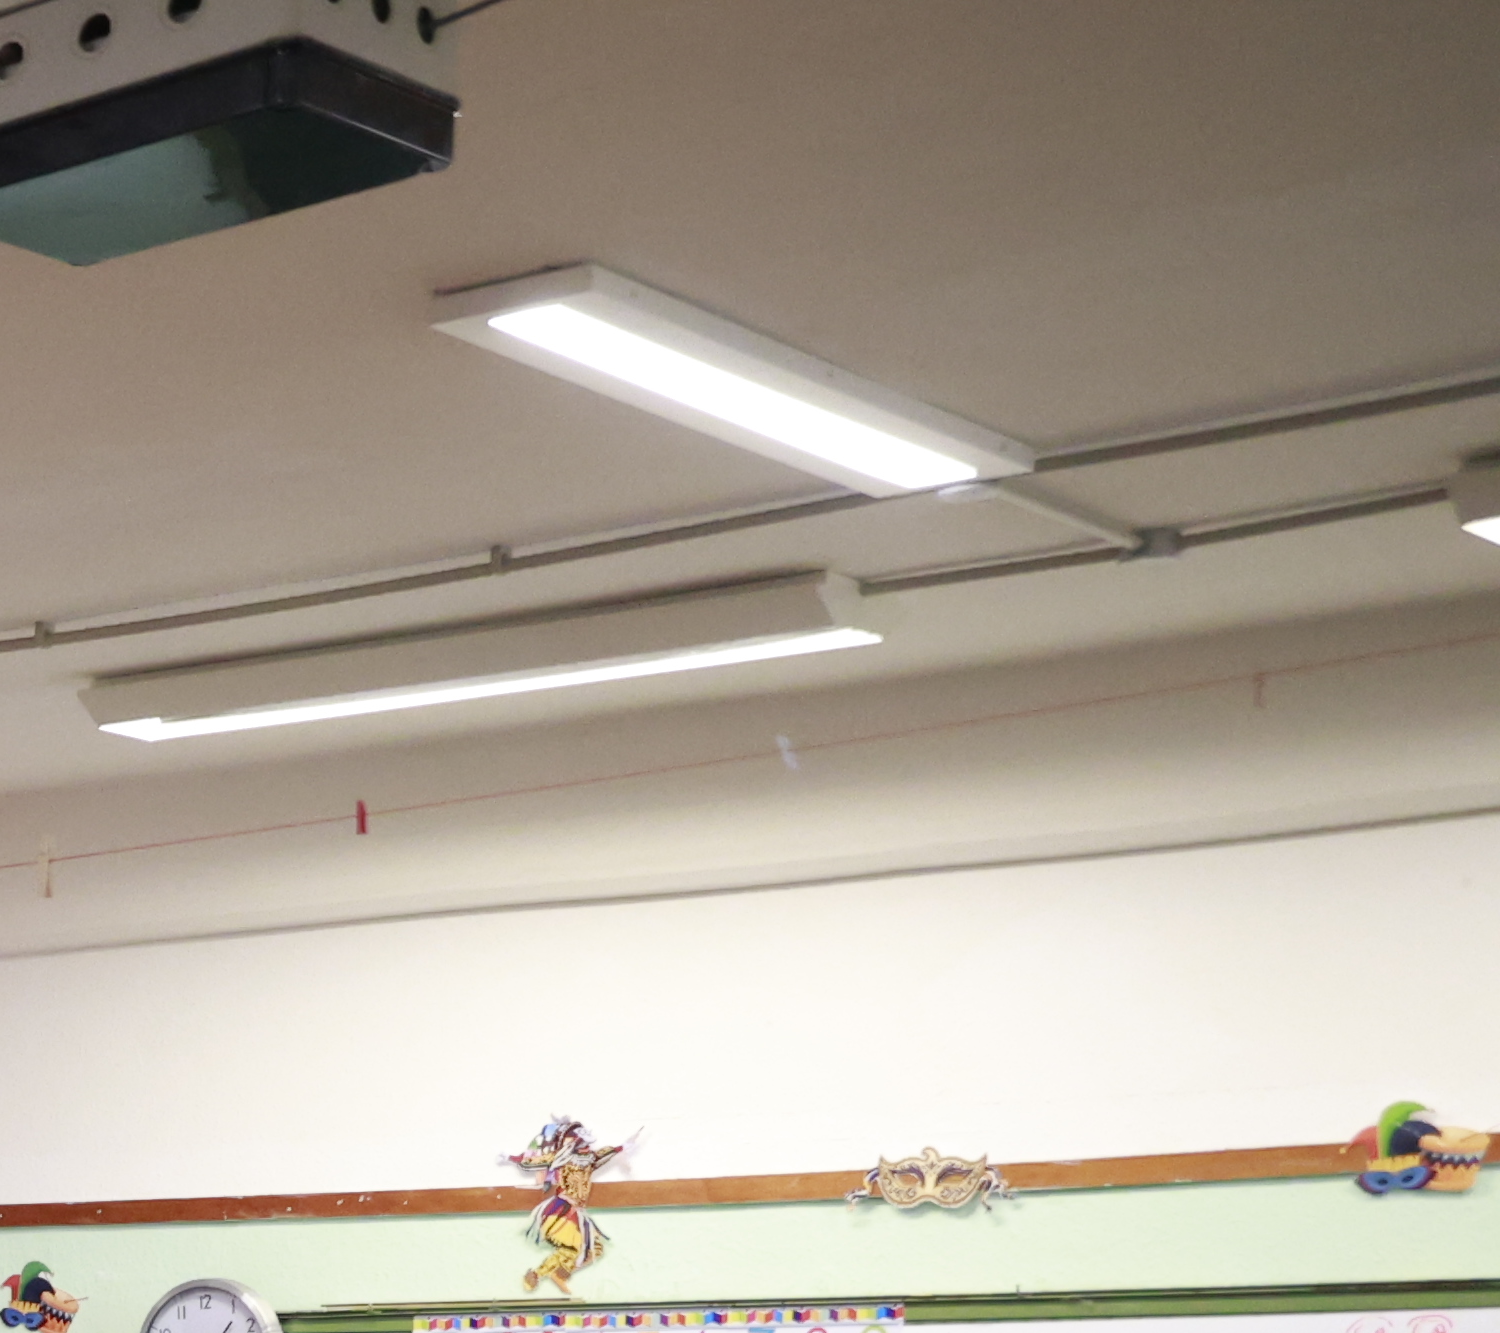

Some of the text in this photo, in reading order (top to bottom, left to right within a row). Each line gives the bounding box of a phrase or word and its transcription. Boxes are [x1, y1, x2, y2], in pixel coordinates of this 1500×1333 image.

[200, 1294, 212, 1310] 12
[231, 1298, 236, 1314] 1
[177, 1305, 186, 1320] 11
[246, 1318, 256, 1333] 2
